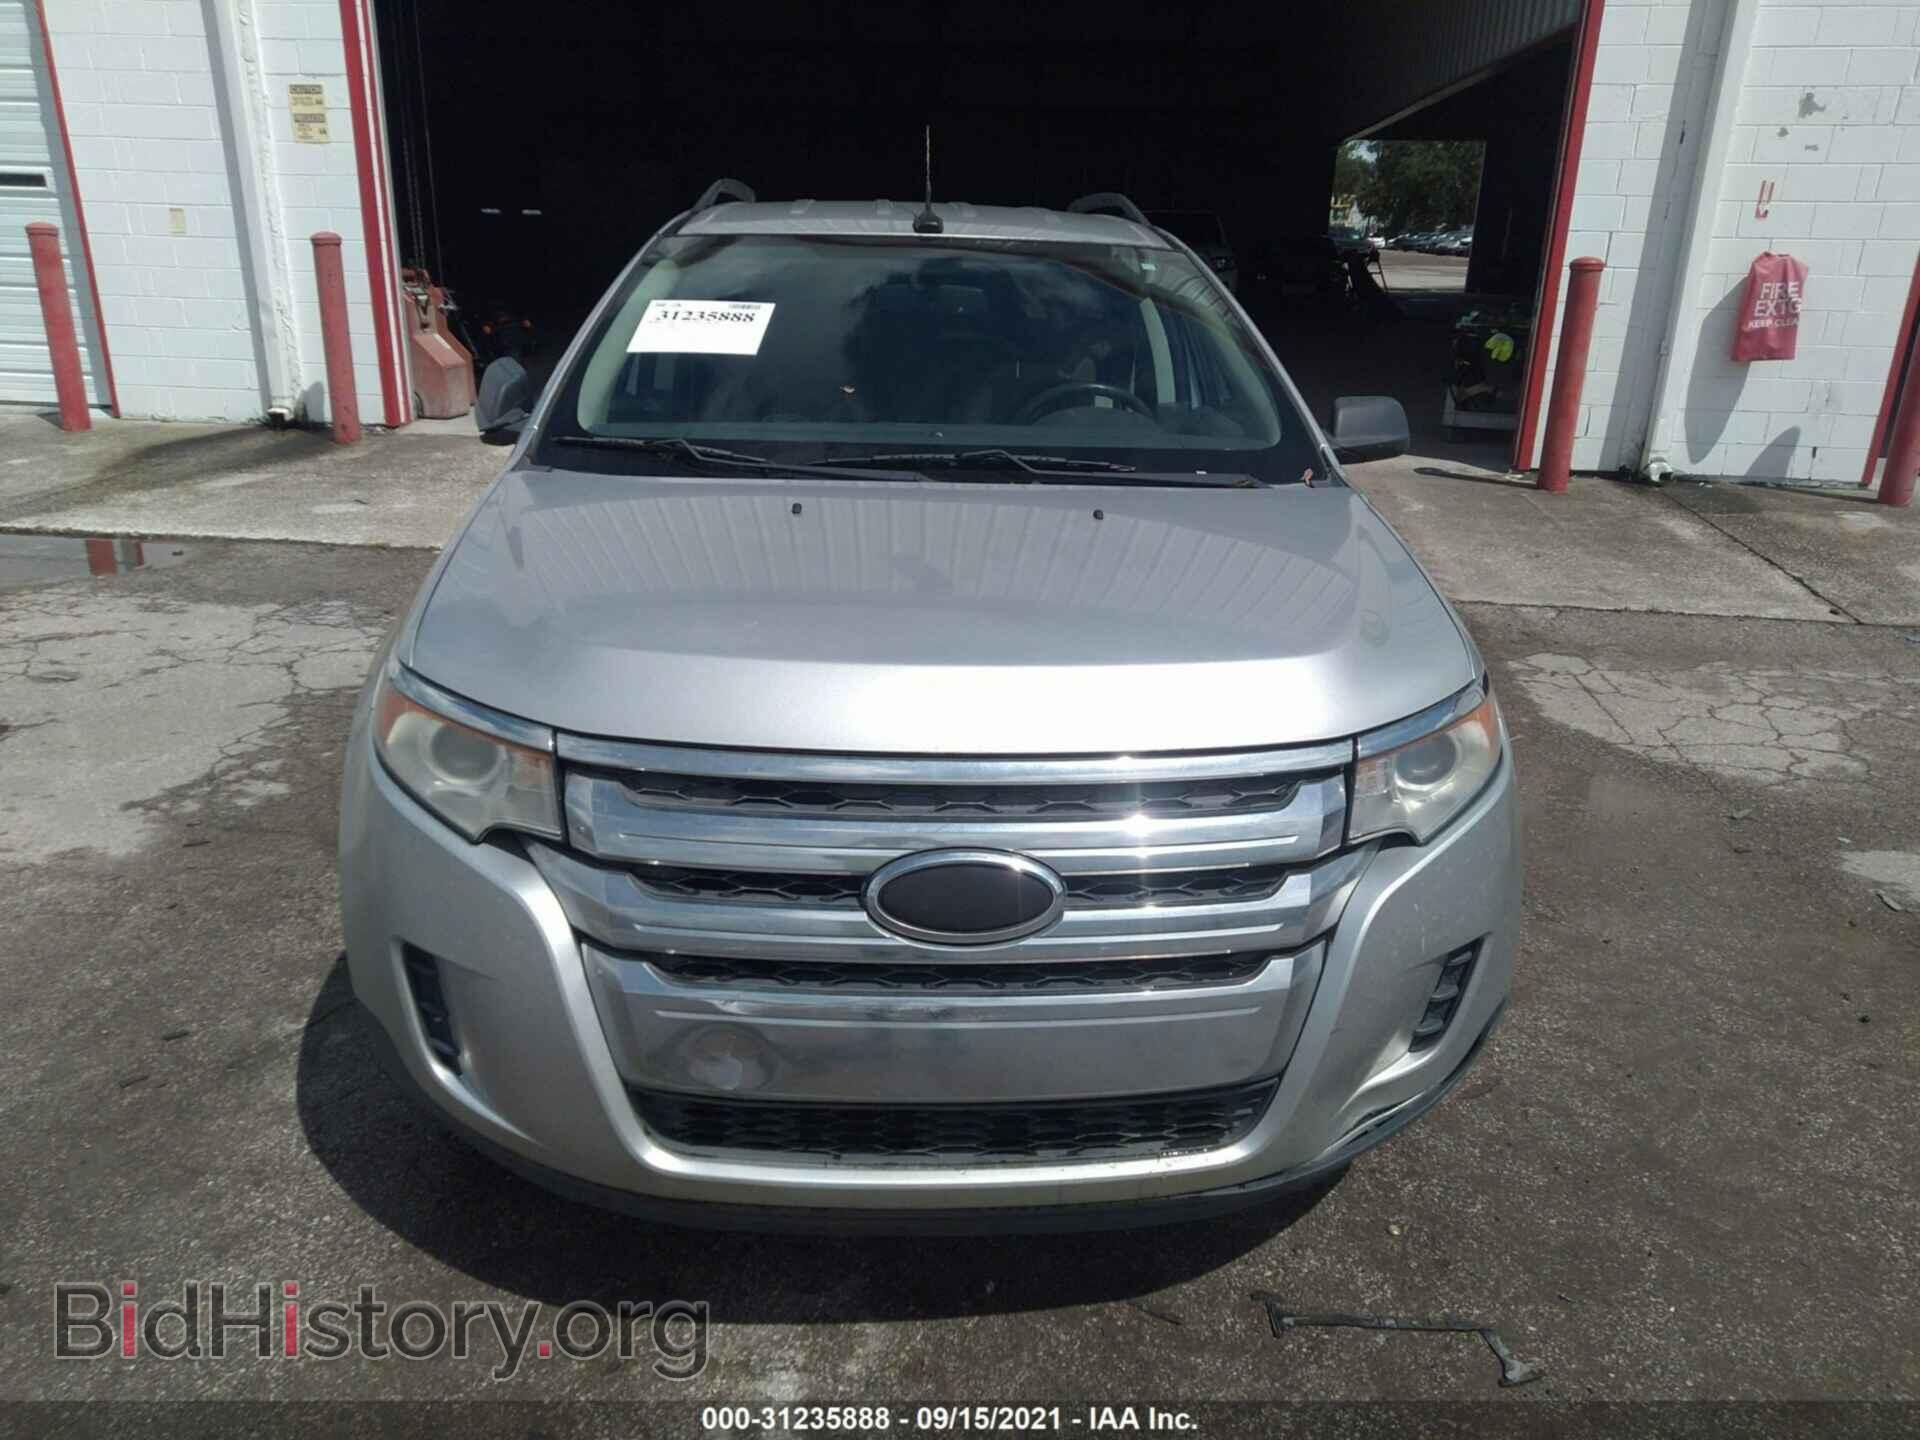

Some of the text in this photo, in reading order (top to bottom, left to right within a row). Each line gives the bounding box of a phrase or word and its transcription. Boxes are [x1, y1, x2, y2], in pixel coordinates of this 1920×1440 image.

[1760, 281, 1799, 299] FIRE
[656, 310, 755, 322] 31235888
[1748, 318, 1799, 329] KEEP CLEA
